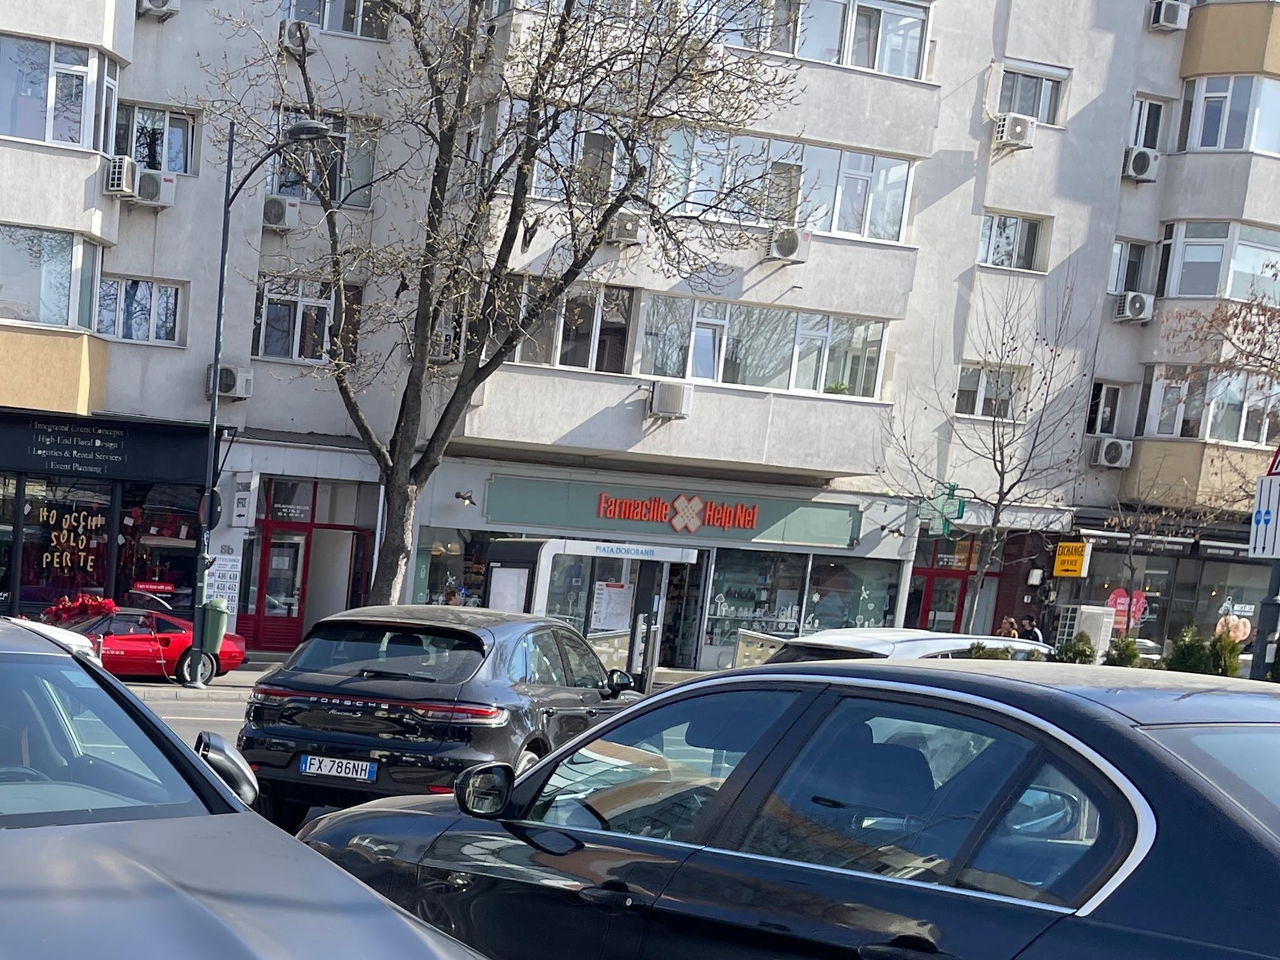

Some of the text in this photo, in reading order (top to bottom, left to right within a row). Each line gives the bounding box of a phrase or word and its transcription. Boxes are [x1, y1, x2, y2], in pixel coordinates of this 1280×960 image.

[37, 434, 118, 450] High-End Floral Design
[32, 447, 62, 457] Logistics
[72, 450, 93, 459] Rental
[94, 453, 122, 462] Services
[50, 461, 103, 474] Event Planning
[39, 507, 57, 525] HO
[704, 501, 733, 531] Help
[734, 503, 759, 529] Net
[50, 529, 87, 549] SOLO
[220, 544, 234, 555] 8b
[1058, 545, 1084, 556] EXCHANGE
[42, 551, 95, 571] PER TE
[309, 696, 389, 709] PORSCHE
